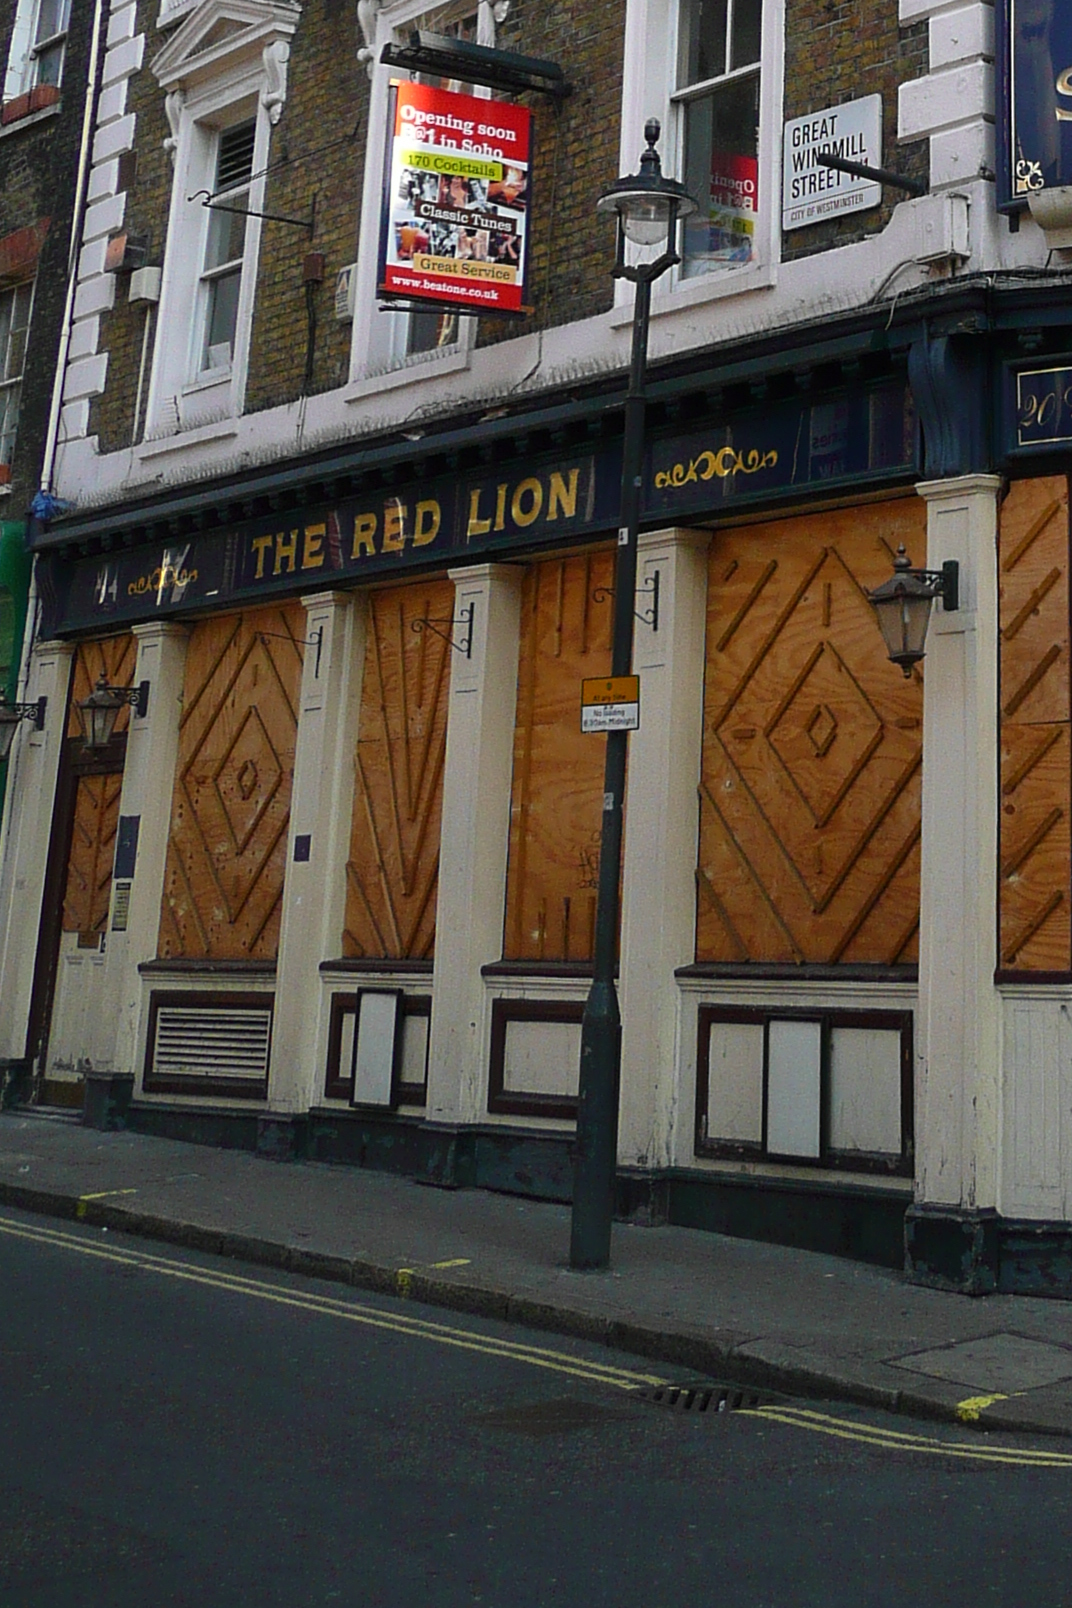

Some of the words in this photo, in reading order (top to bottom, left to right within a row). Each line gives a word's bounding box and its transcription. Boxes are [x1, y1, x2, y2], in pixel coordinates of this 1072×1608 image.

[400, 104, 475, 135] Opening
[477, 124, 517, 141] soon
[792, 115, 838, 148] GREAT
[440, 134, 457, 150] in
[461, 139, 503, 159] Soho
[792, 132, 867, 173] WINDMILL
[408, 155, 430, 167] 170
[434, 158, 495, 177] Cocktails
[791, 167, 841, 199] STREET
[420, 204, 469, 223] Classic
[471, 214, 512, 232] Tunes
[791, 209, 804, 222] CITY
[807, 207, 815, 217] OF
[816, 193, 864, 215] WESTMINSTER
[420, 258, 458, 273] Great
[461, 263, 510, 280] Service
[391, 276, 499, 300] www.beatone.co.uk
[1020, 393, 1055, 427] 20
[252, 523, 326, 579] THE
[350, 499, 441, 559] RED
[467, 468, 580, 536] LION
